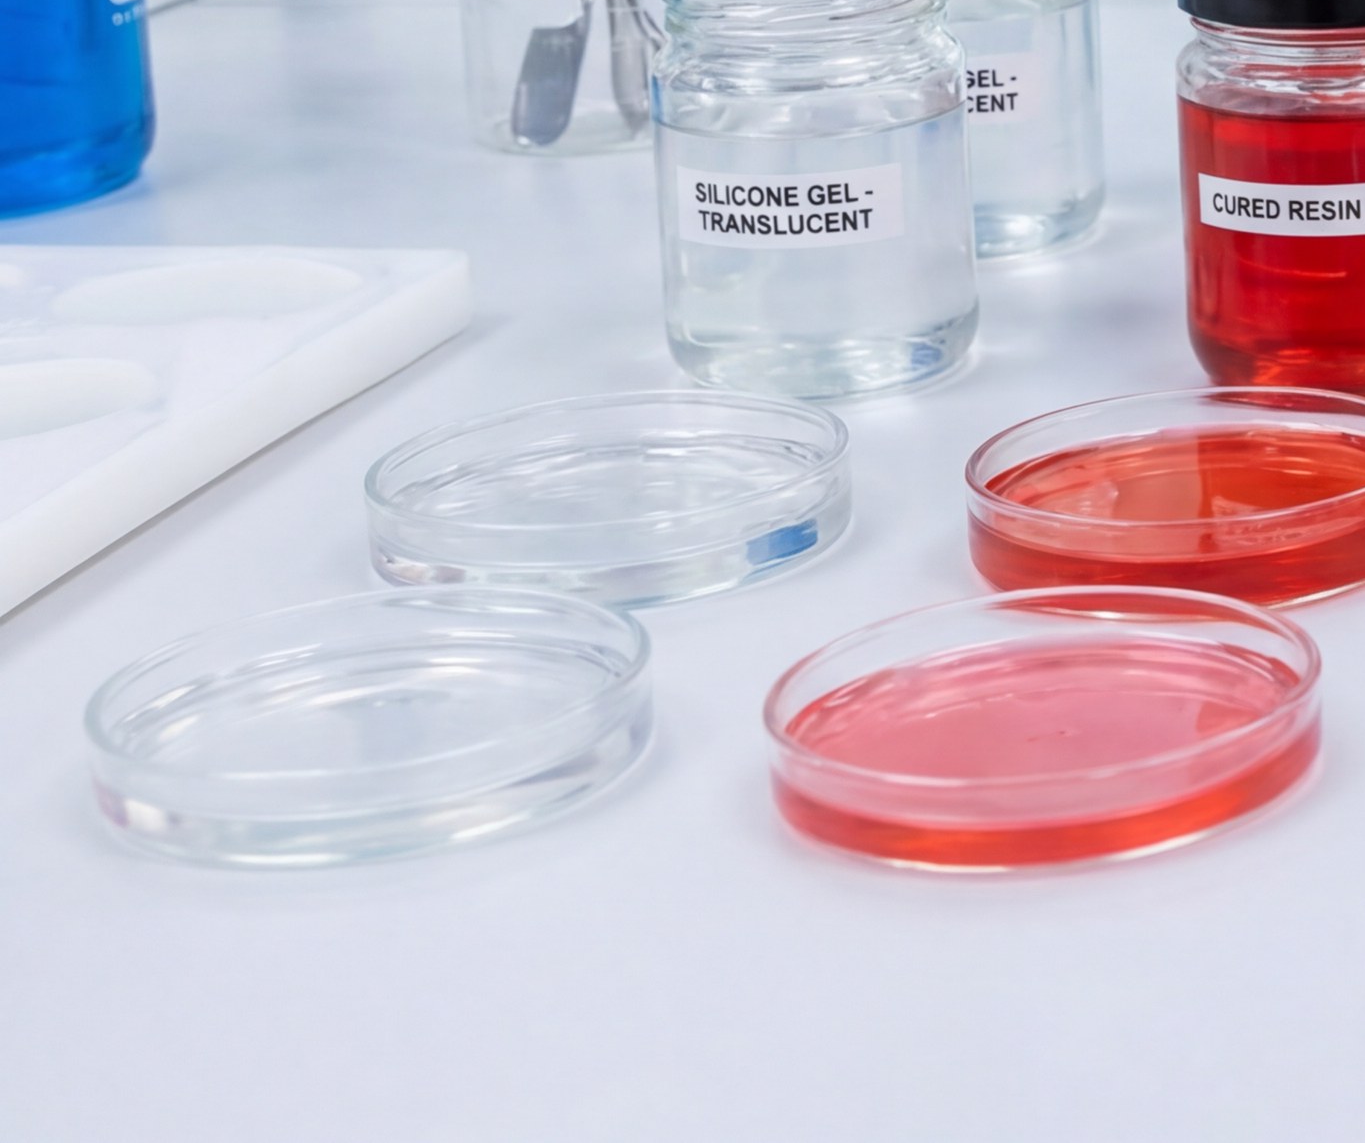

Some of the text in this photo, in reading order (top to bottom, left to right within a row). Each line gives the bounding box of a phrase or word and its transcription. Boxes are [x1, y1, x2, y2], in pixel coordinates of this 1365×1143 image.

[695, 182, 800, 207] SILICONE
[807, 182, 859, 206] GEL
[1212, 192, 1281, 219] CURED
[1288, 199, 1361, 221] RESIN
[698, 208, 873, 235] TRANSLUCENT
